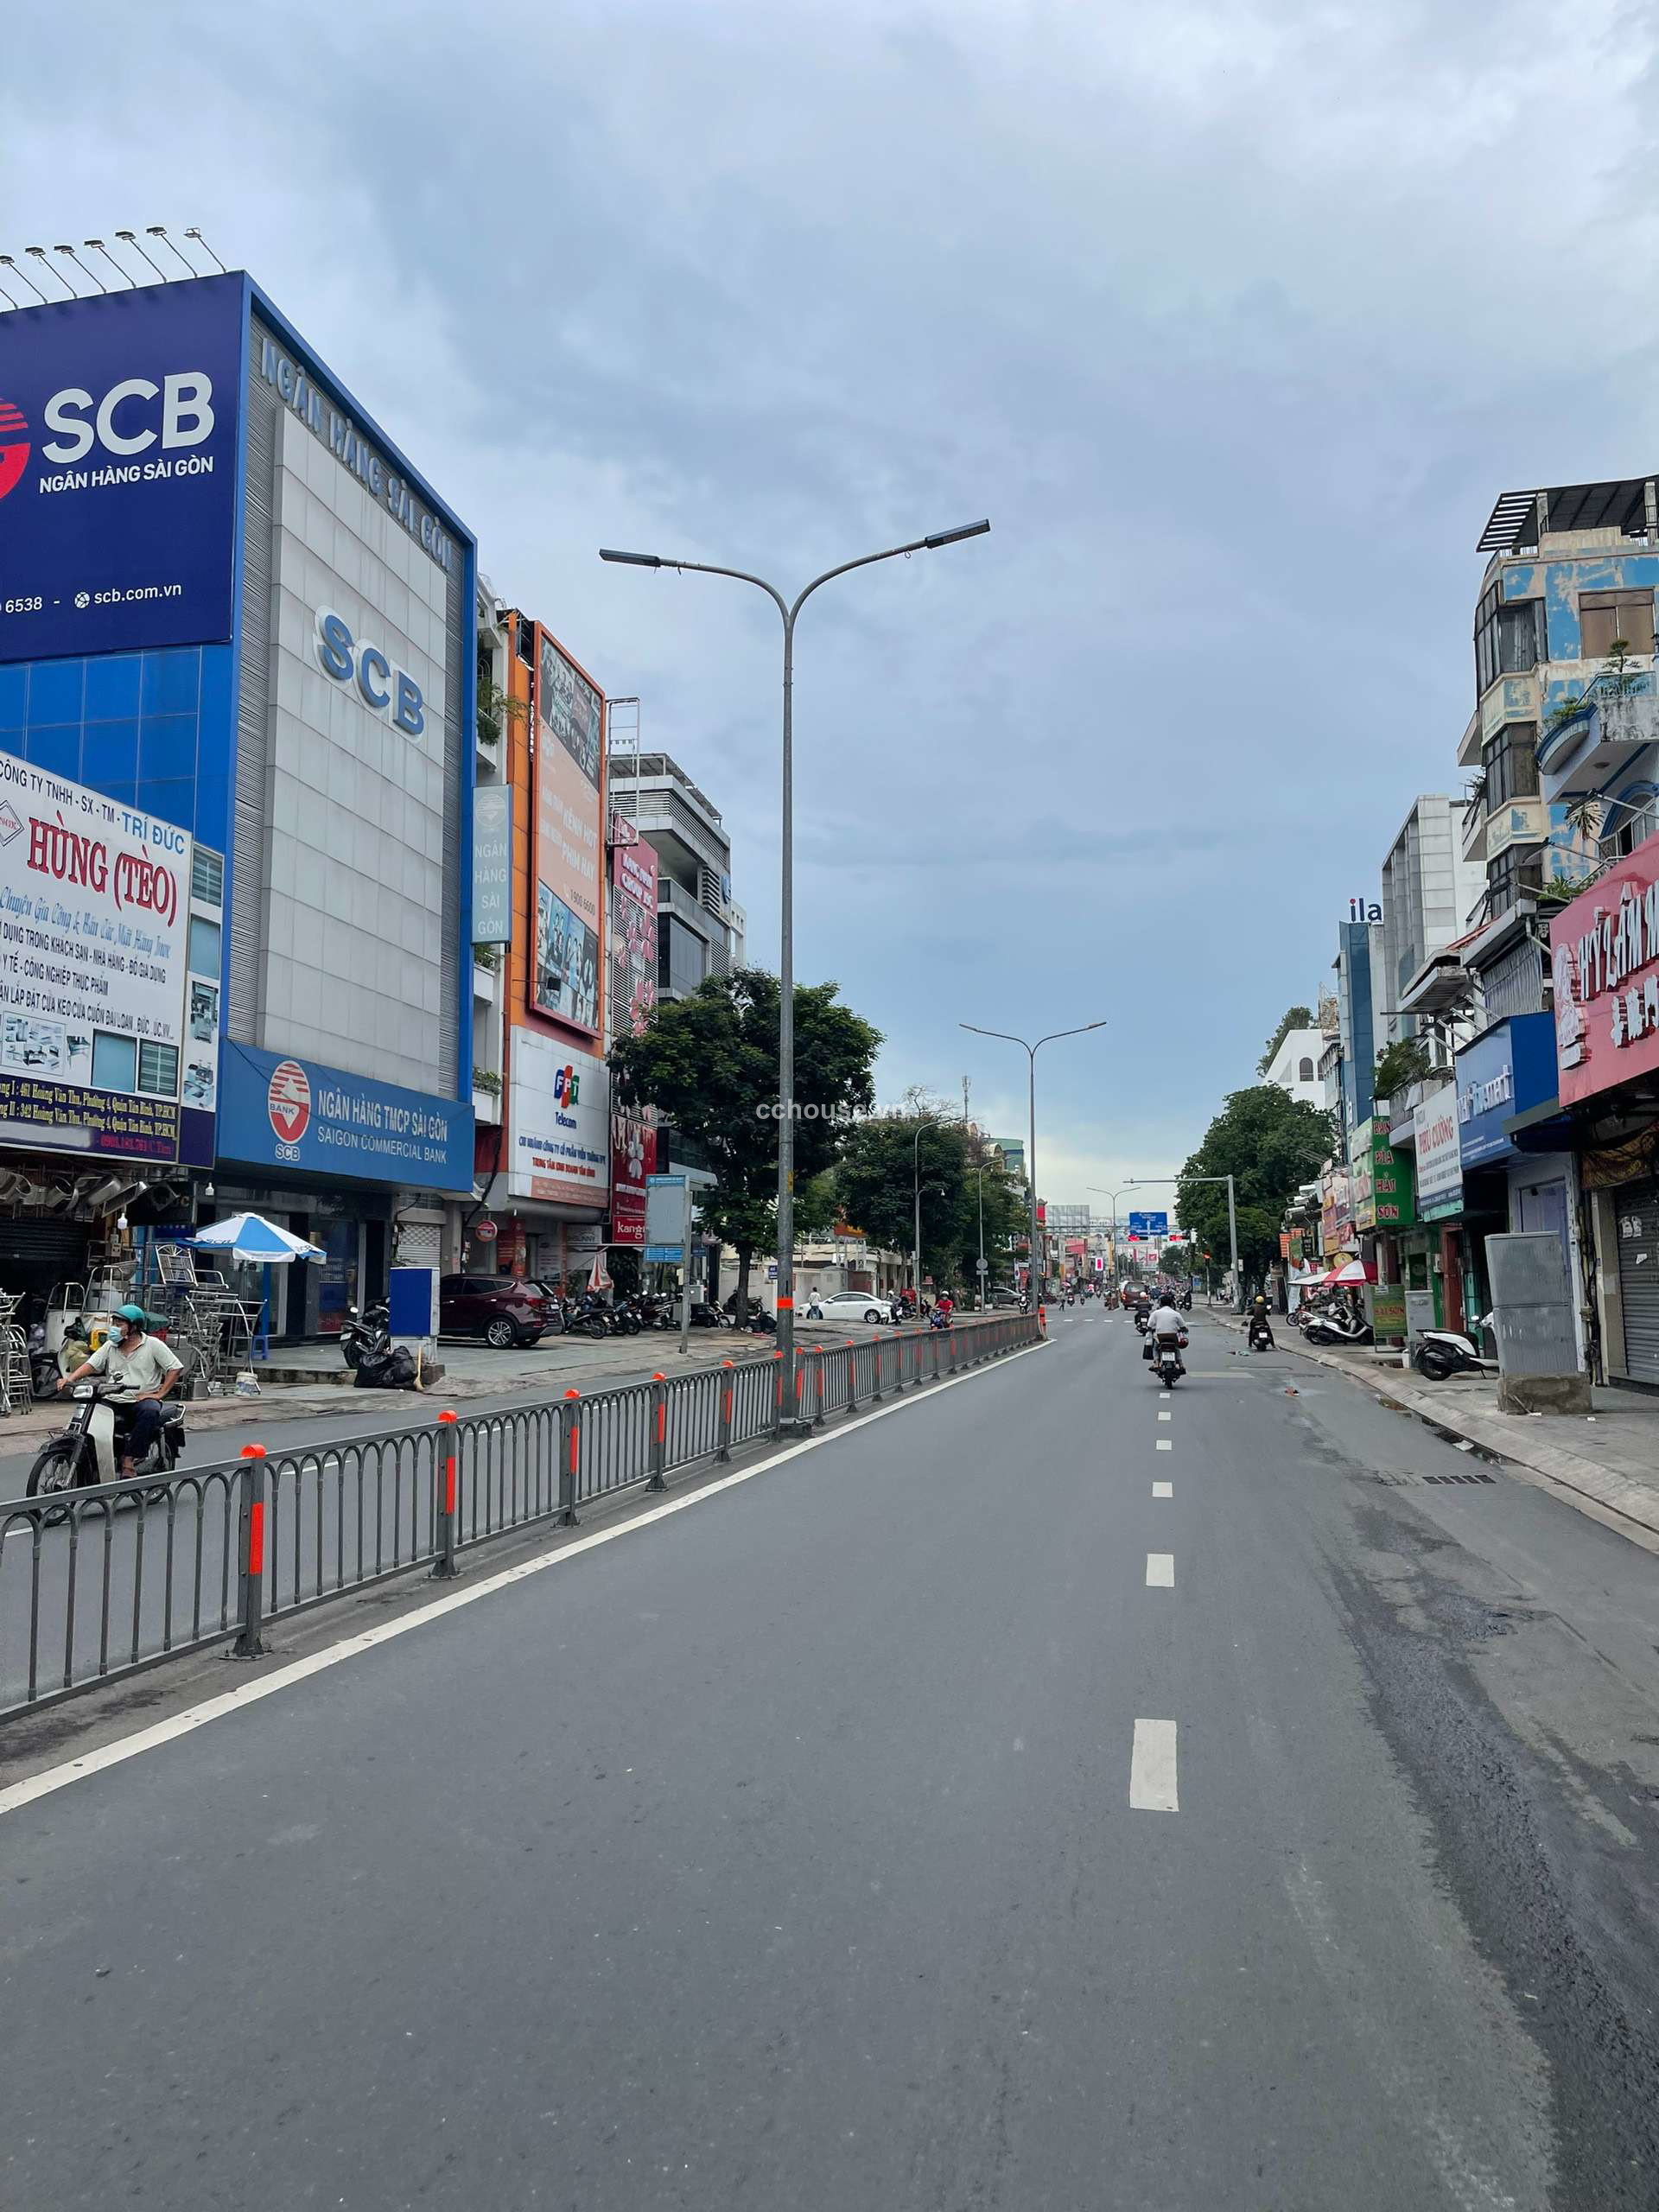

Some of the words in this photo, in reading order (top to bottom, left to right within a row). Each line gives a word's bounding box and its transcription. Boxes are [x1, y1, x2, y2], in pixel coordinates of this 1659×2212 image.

[41, 372, 215, 464] SCB
[261, 338, 322, 432] NGÂN
[329, 411, 383, 493] HÀNG
[388, 477, 415, 532] SÀI
[421, 515, 451, 570] GÒN
[40, 470, 87, 493] NGÂN
[91, 466, 141, 488] HÀNG
[143, 459, 172, 479] SÀI
[175, 455, 213, 476] GÒN
[5, 596, 42, 613] 6538
[94, 584, 182, 605] scb.com.vn
[315, 612, 425, 736] SCB
[30, 774, 43, 793] TY
[46, 780, 73, 806] TNHH
[81, 795, 93, 815] SX
[102, 804, 115, 823] TM
[122, 811, 148, 840] TRÍ
[152, 825, 185, 855] ĐỨC
[475, 840, 506, 858] NGÂN
[27, 810, 109, 893] HÙNG
[114, 844, 177, 927] (TÈO)
[475, 866, 506, 885] HÀNG
[481, 891, 499, 909] SÀI
[1350, 898, 1382, 922] ila
[478, 917, 504, 935] GÒN
[26, 929, 49, 950] TRONG
[270, 1103, 295, 1116] BANK
[318, 1087, 349, 1121] NGÂN
[352, 1093, 381, 1128] HÀNG
[384, 1106, 410, 1133] TMCP
[412, 1107, 427, 1138] SÀI
[429, 1111, 448, 1142] GÒN
[556, 1111, 576, 1128] Telecom
[276, 1143, 300, 1161] SCB
[318, 1126, 358, 1148] SAIGON
[361, 1136, 422, 1160] COMMERCIAL
[424, 1147, 447, 1164] BANK
